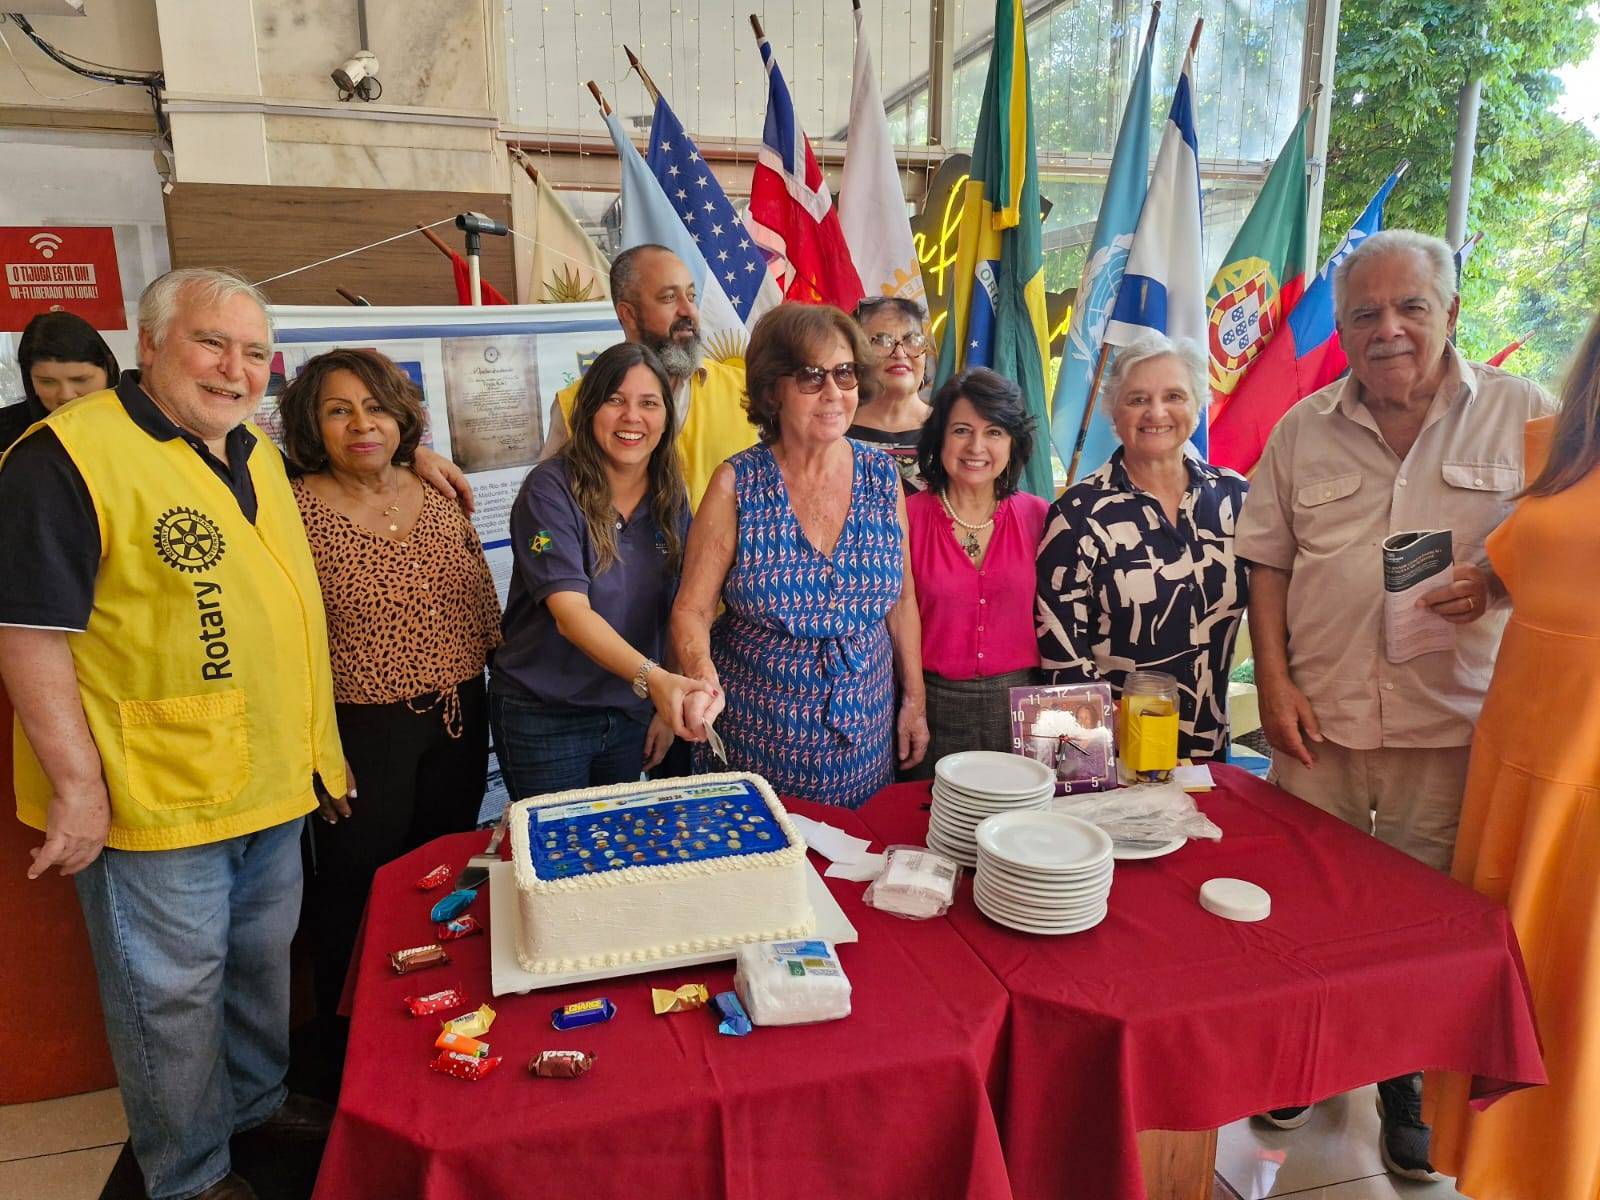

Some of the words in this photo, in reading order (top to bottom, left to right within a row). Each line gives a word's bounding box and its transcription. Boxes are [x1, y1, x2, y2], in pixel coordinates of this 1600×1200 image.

[12, 266, 19, 281] O
[74, 265, 90, 281] ON!
[9, 286, 30, 299] WI-FI
[30, 286, 64, 299] LIBERADO
[64, 286, 75, 299] NO
[75, 286, 99, 299] LOCAL!
[161, 528, 176, 559] ROTARY
[193, 581, 233, 681] Rotary
[1028, 693, 1040, 705] 11
[1085, 691, 1091, 702] 1
[1013, 710, 1025, 722] 10
[1103, 704, 1111, 716] 2
[1013, 737, 1021, 749] 9
[1107, 756, 1114, 767] 4
[1064, 782, 1072, 793] 6
[1091, 776, 1099, 788] 5
